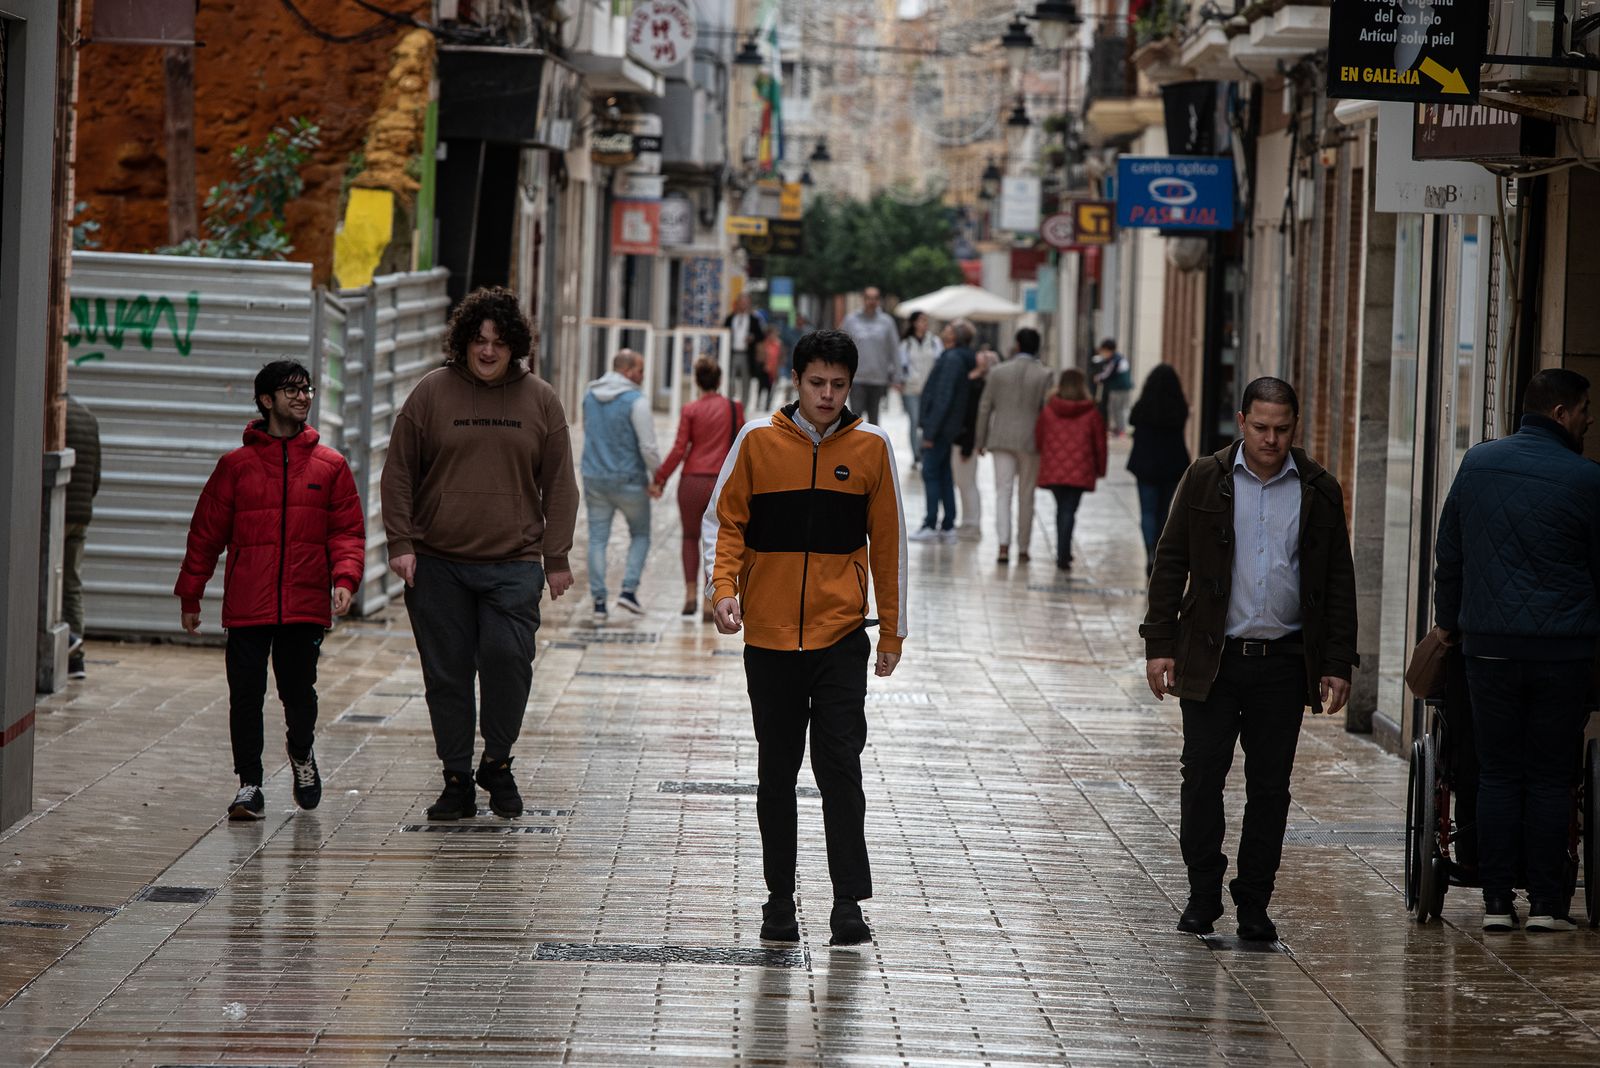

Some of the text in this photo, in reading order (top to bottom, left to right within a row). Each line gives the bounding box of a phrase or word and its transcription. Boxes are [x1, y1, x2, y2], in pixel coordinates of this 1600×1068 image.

[1375, 8, 1394, 23] del
[1431, 31, 1455, 48] piel
[1340, 66, 1421, 85] EN GALERIA
[1130, 162, 1174, 175] centro
[1129, 204, 1218, 225] PASUAL
[453, 418, 470, 427] ONE
[472, 418, 491, 427] WITH
